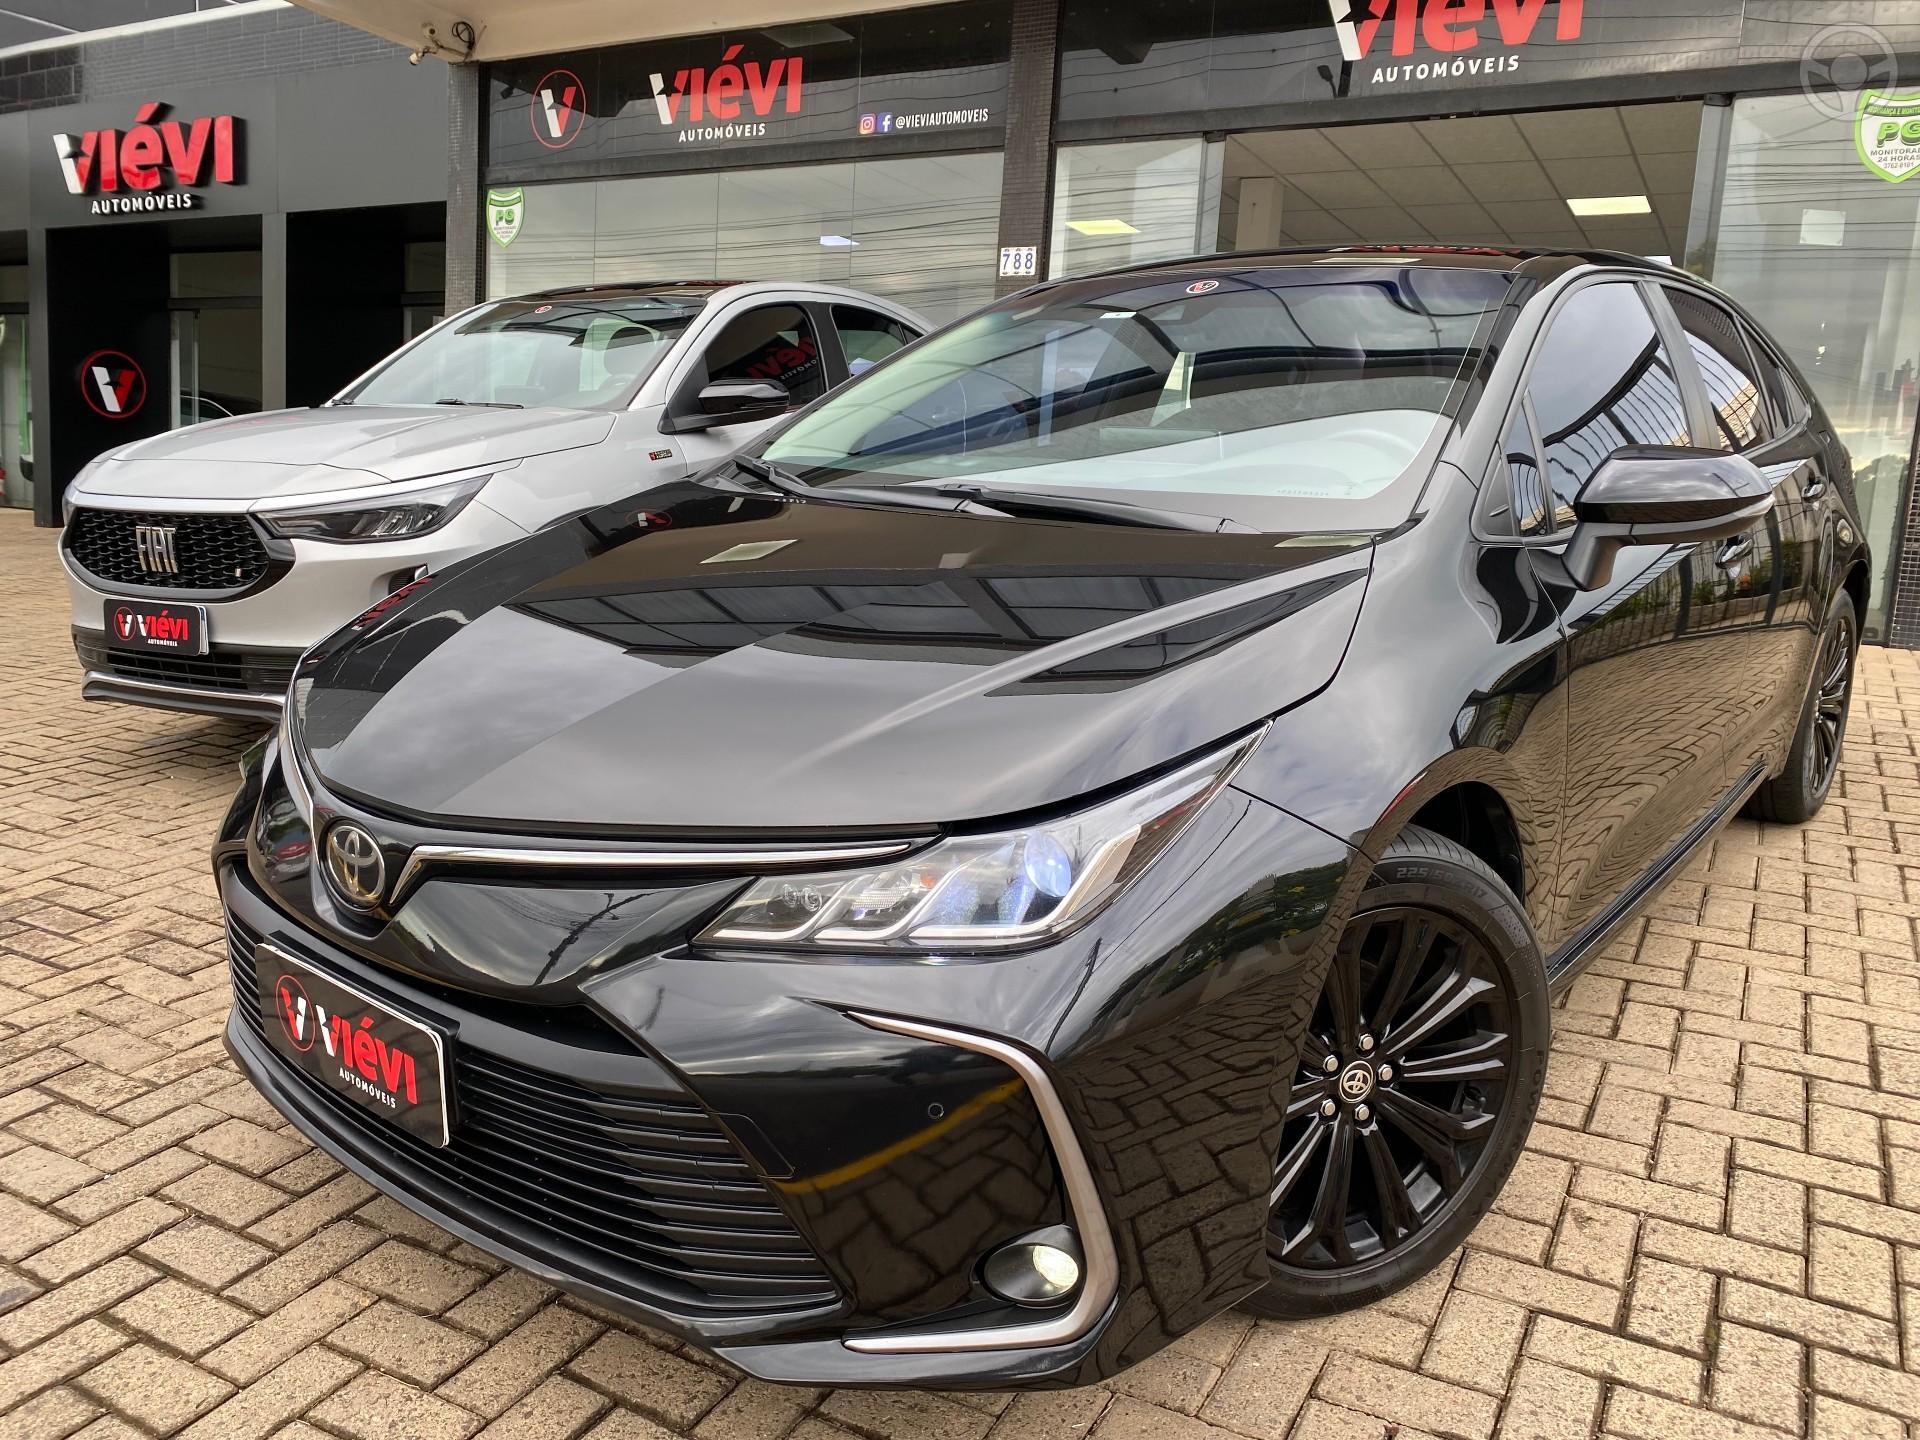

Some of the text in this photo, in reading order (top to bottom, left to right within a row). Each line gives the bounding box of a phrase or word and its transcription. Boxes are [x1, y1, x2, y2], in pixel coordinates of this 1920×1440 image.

[1371, 55, 1520, 84] AUTOMÓVEIS
[895, 108, 989, 129] @VIEVIAUTOMOVEIS
[679, 123, 766, 143] AUTOMÓVEIS
[1877, 120, 1920, 147] PG
[91, 191, 193, 214] AUTOMÓVEIS
[1002, 252, 1034, 270] 788
[135, 526, 179, 574] FIAT
[147, 638, 178, 647] AUTOMÓVEIS
[338, 1066, 397, 1109] AUTOMÓVEIS
